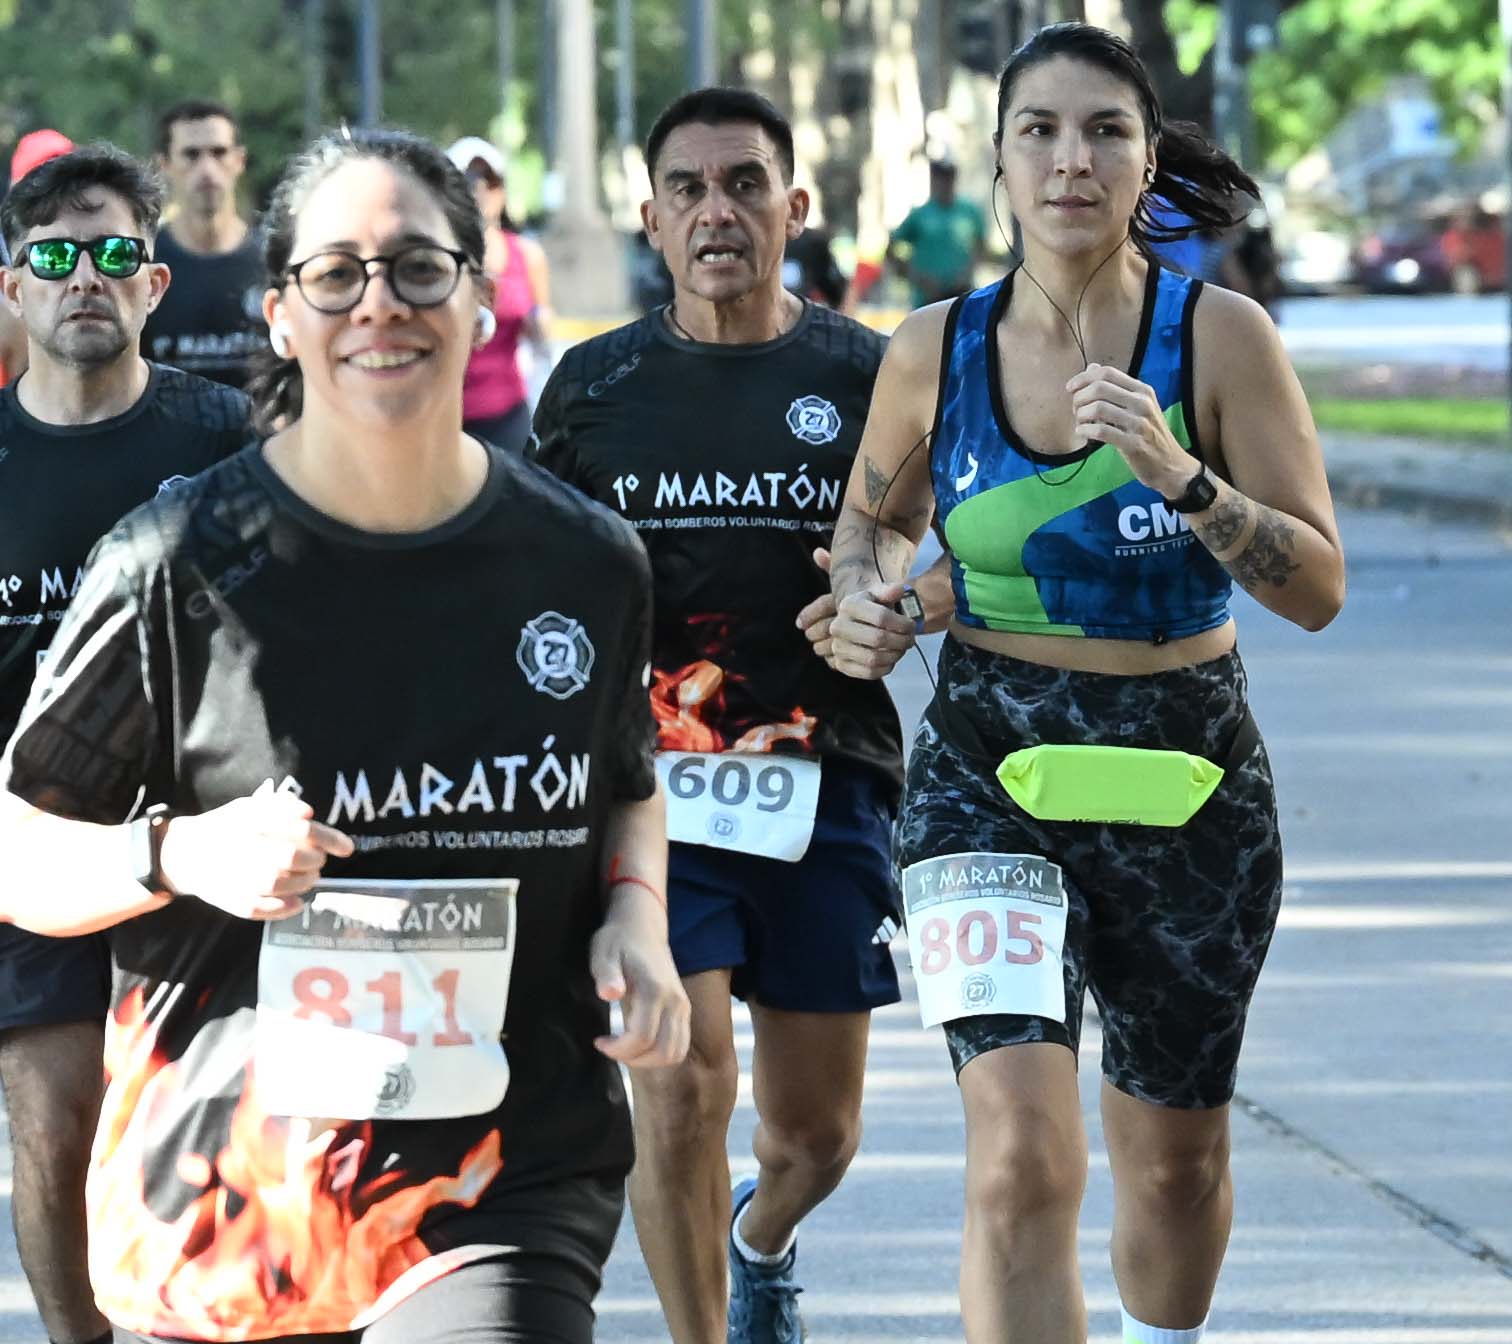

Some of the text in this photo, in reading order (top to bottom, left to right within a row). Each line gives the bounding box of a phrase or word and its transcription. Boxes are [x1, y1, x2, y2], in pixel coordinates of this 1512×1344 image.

[805, 411, 824, 426] 27
[654, 463, 840, 510] MARATÓN
[665, 516, 726, 529] BOMBEROS
[543, 640, 569, 666] 27
[326, 734, 590, 826] MARATÓN
[668, 757, 794, 813] 609
[939, 861, 1043, 889] MARATÓN
[920, 909, 1044, 976] 805
[292, 966, 474, 1047] 811
